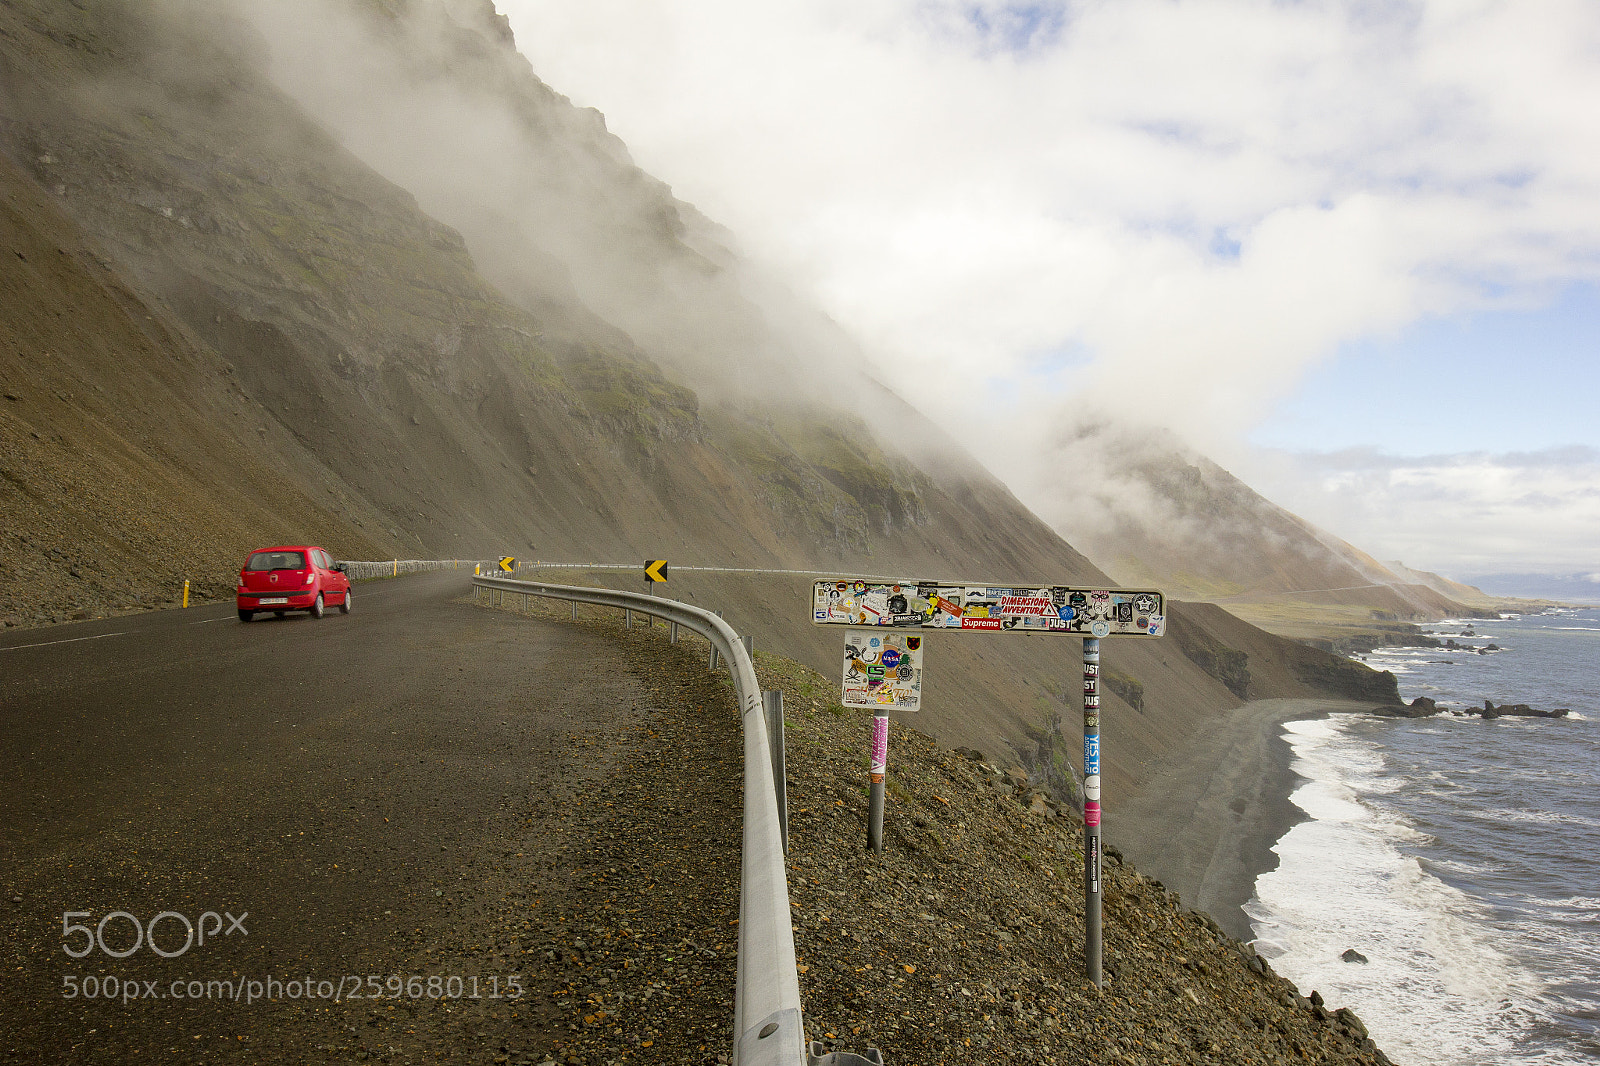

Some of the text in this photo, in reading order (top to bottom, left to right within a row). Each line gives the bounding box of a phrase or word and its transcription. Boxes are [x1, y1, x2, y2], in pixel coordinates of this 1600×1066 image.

[963, 618, 999, 628] Supreme
[1049, 618, 1071, 629] JUST
[1089, 735, 1099, 757] YES
